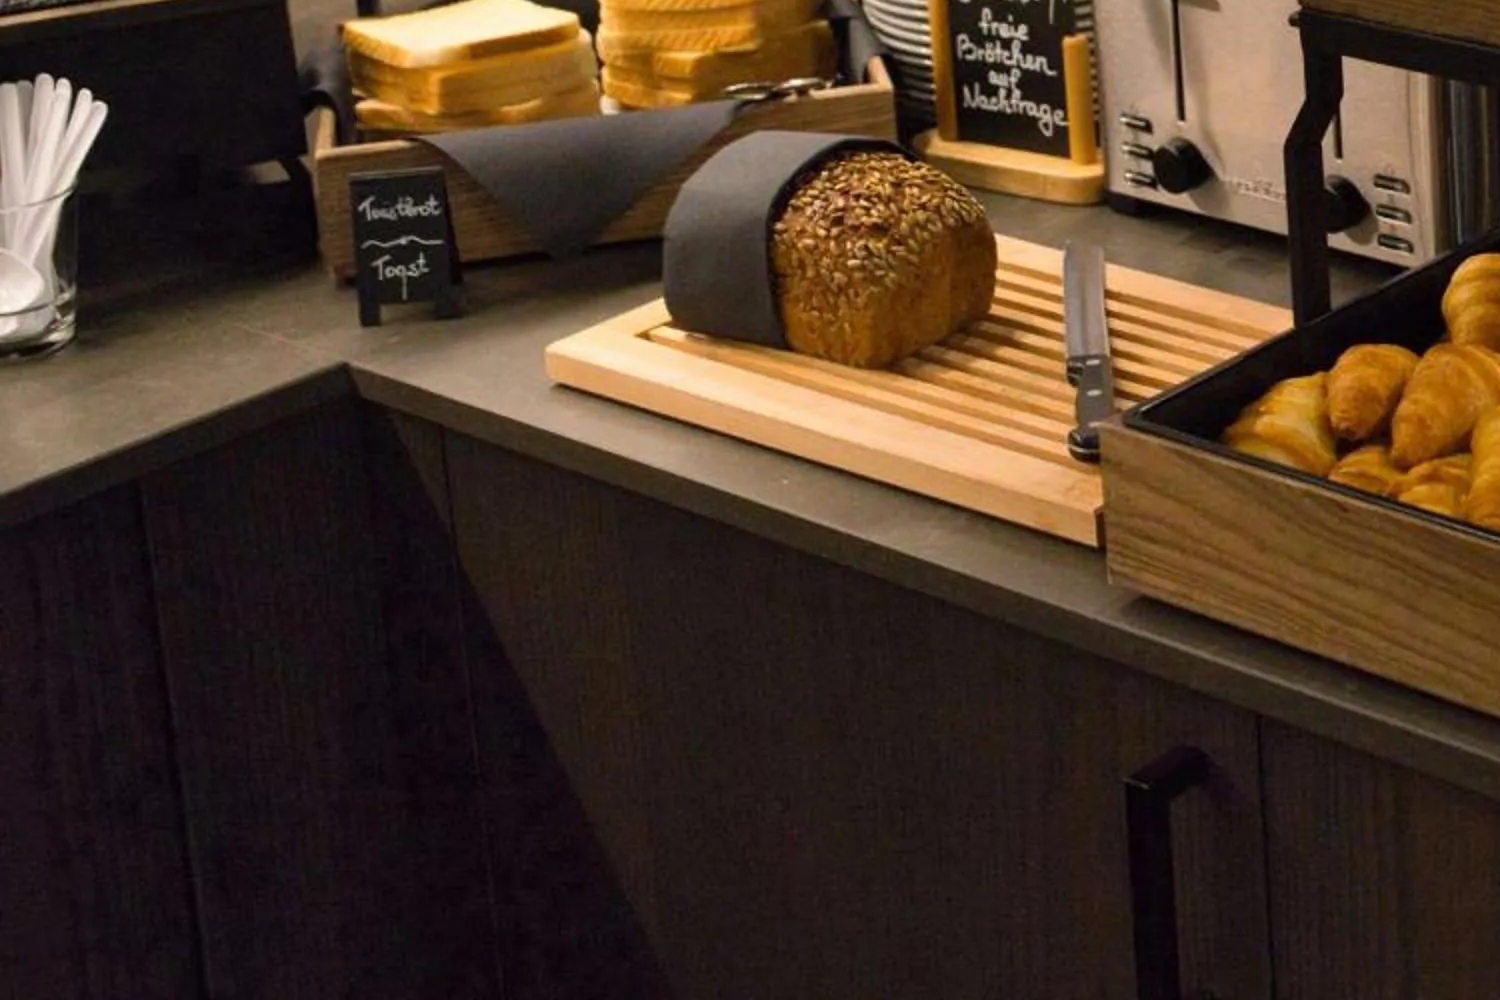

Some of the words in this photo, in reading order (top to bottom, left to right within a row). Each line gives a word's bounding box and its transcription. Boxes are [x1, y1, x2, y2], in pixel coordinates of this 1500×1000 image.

[978, 7, 1030, 41] freie
[956, 33, 1058, 77] Brötchen
[988, 67, 1022, 92] auf
[962, 82, 1071, 138] Nachfrage
